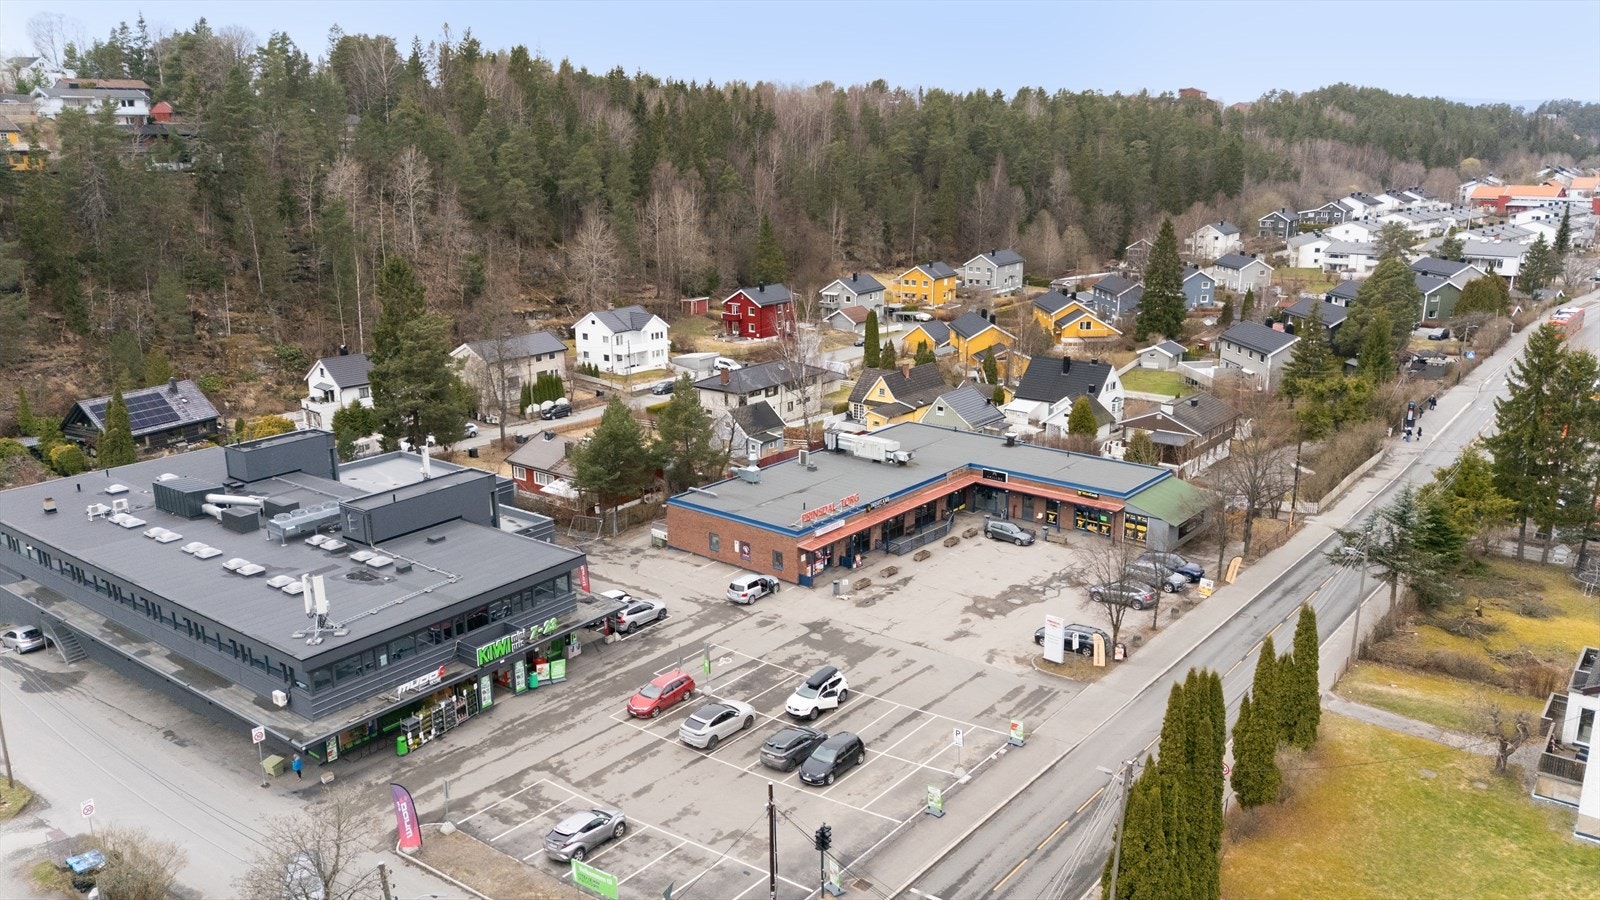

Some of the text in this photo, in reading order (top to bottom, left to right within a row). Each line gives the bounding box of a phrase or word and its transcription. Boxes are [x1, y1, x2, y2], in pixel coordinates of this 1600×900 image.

[801, 502, 836, 522] PRINSDAL
[840, 493, 859, 507] TORG
[476, 635, 512, 667] KIWI
